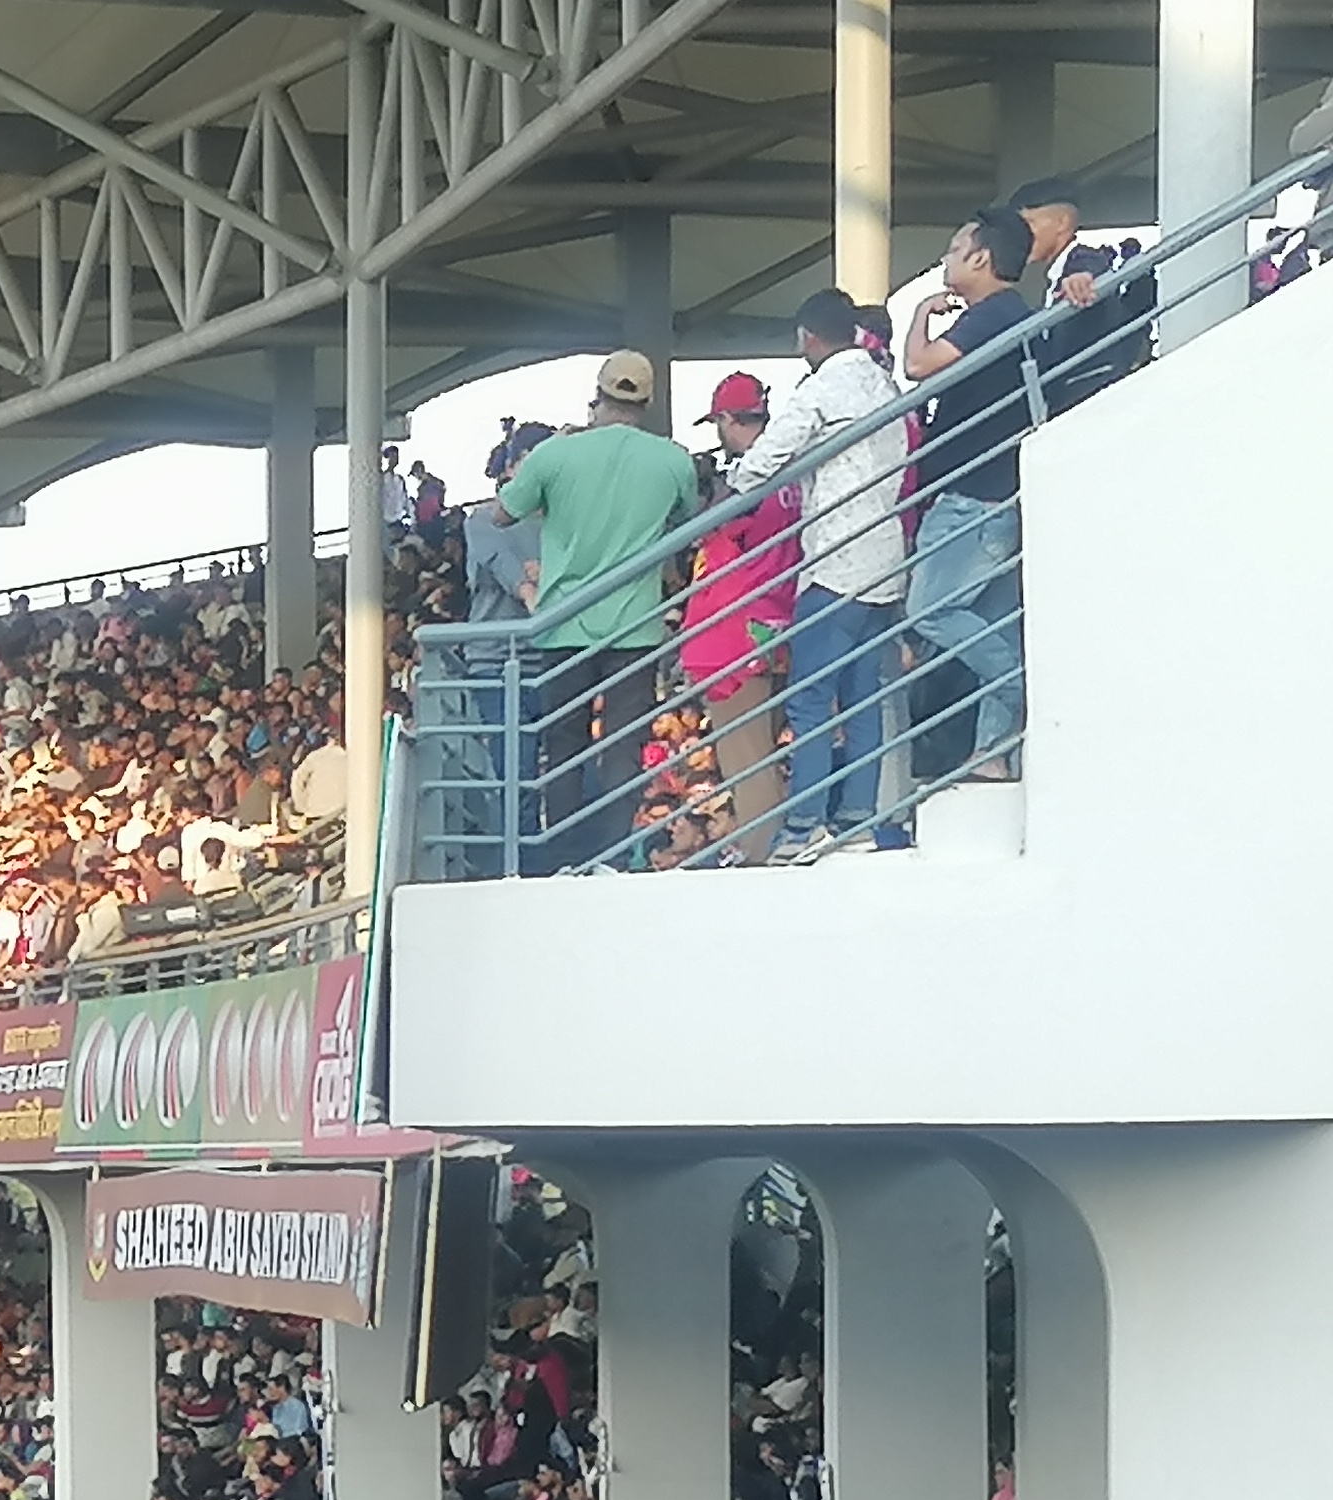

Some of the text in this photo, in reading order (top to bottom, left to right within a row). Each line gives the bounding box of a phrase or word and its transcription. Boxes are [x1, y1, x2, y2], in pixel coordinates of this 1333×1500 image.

[114, 1203, 208, 1271] SHAHEED
[209, 1207, 250, 1277] ABU
[250, 1211, 301, 1281] SAYED
[301, 1212, 350, 1285] STAND
